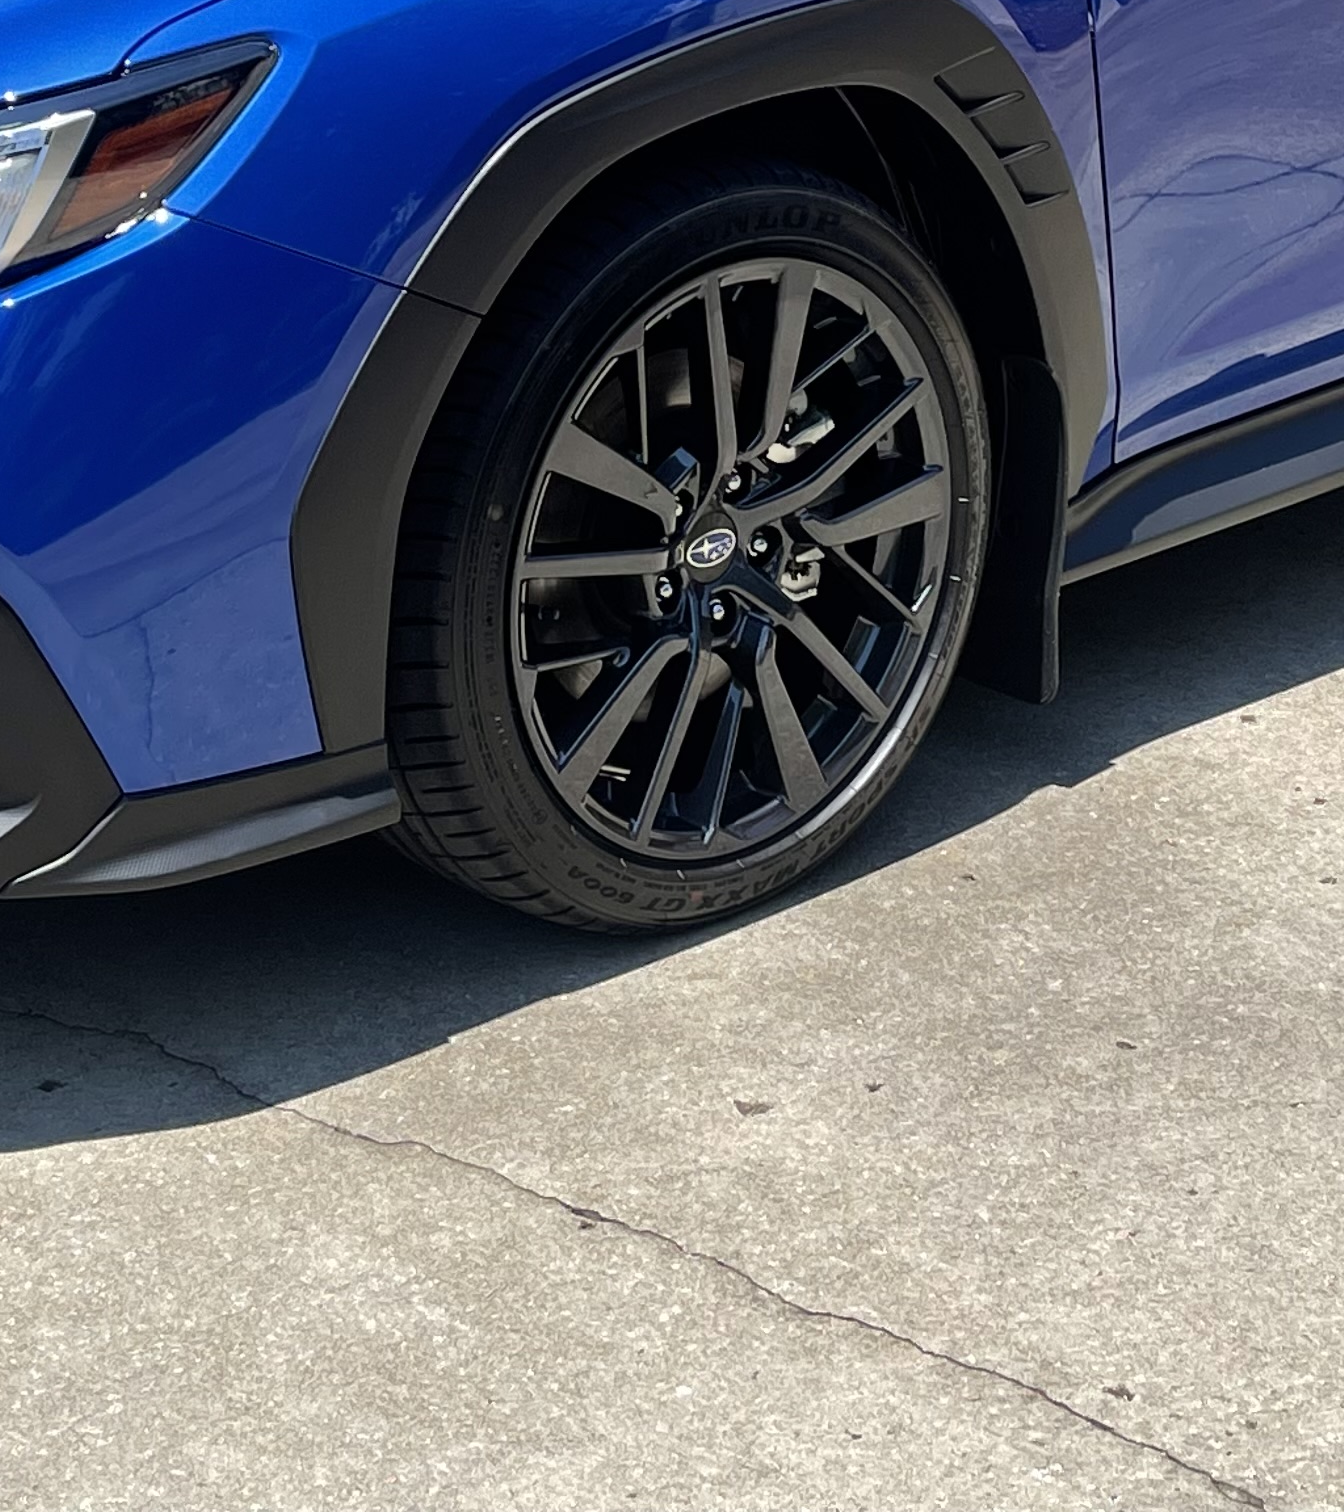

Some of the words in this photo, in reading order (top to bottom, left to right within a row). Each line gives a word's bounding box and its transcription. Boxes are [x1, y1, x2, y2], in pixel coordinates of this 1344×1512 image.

[672, 204, 842, 254] UNLOP
[566, 865, 635, 905] 600A
[640, 896, 687, 913] GT
[696, 859, 799, 911] MAXX
